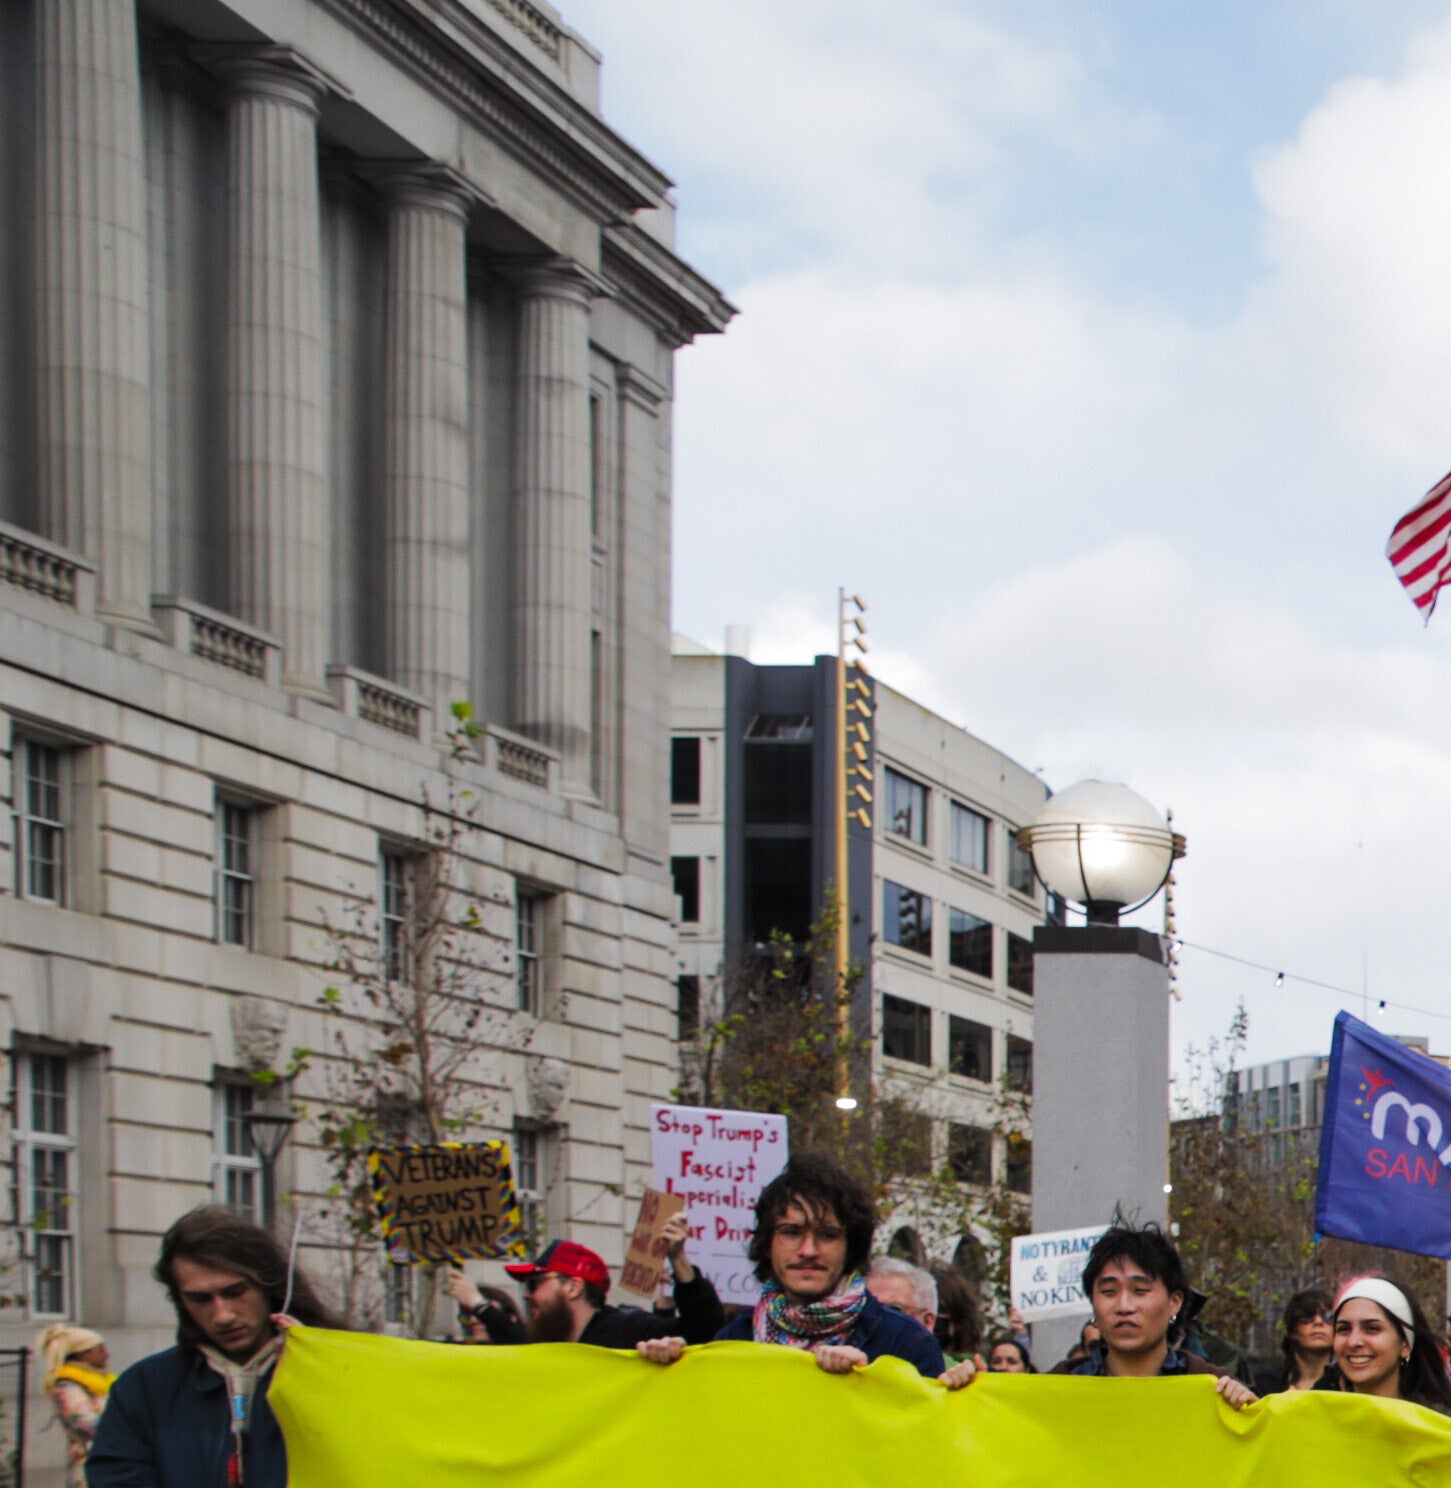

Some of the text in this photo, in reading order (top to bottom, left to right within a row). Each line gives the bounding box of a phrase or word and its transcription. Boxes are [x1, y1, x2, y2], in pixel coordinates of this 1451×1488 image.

[656, 1110, 779, 1153] Stop Trump's
[380, 1152, 497, 1184] VETERANS
[681, 1150, 757, 1183] Fascist
[1365, 1148, 1439, 1186] SAN
[396, 1187, 490, 1218] AGAINST
[399, 1214, 497, 1251] TRUMP
[1041, 1235, 1101, 1257] TYRANT
[1021, 1286, 1084, 1309] NO KIN
